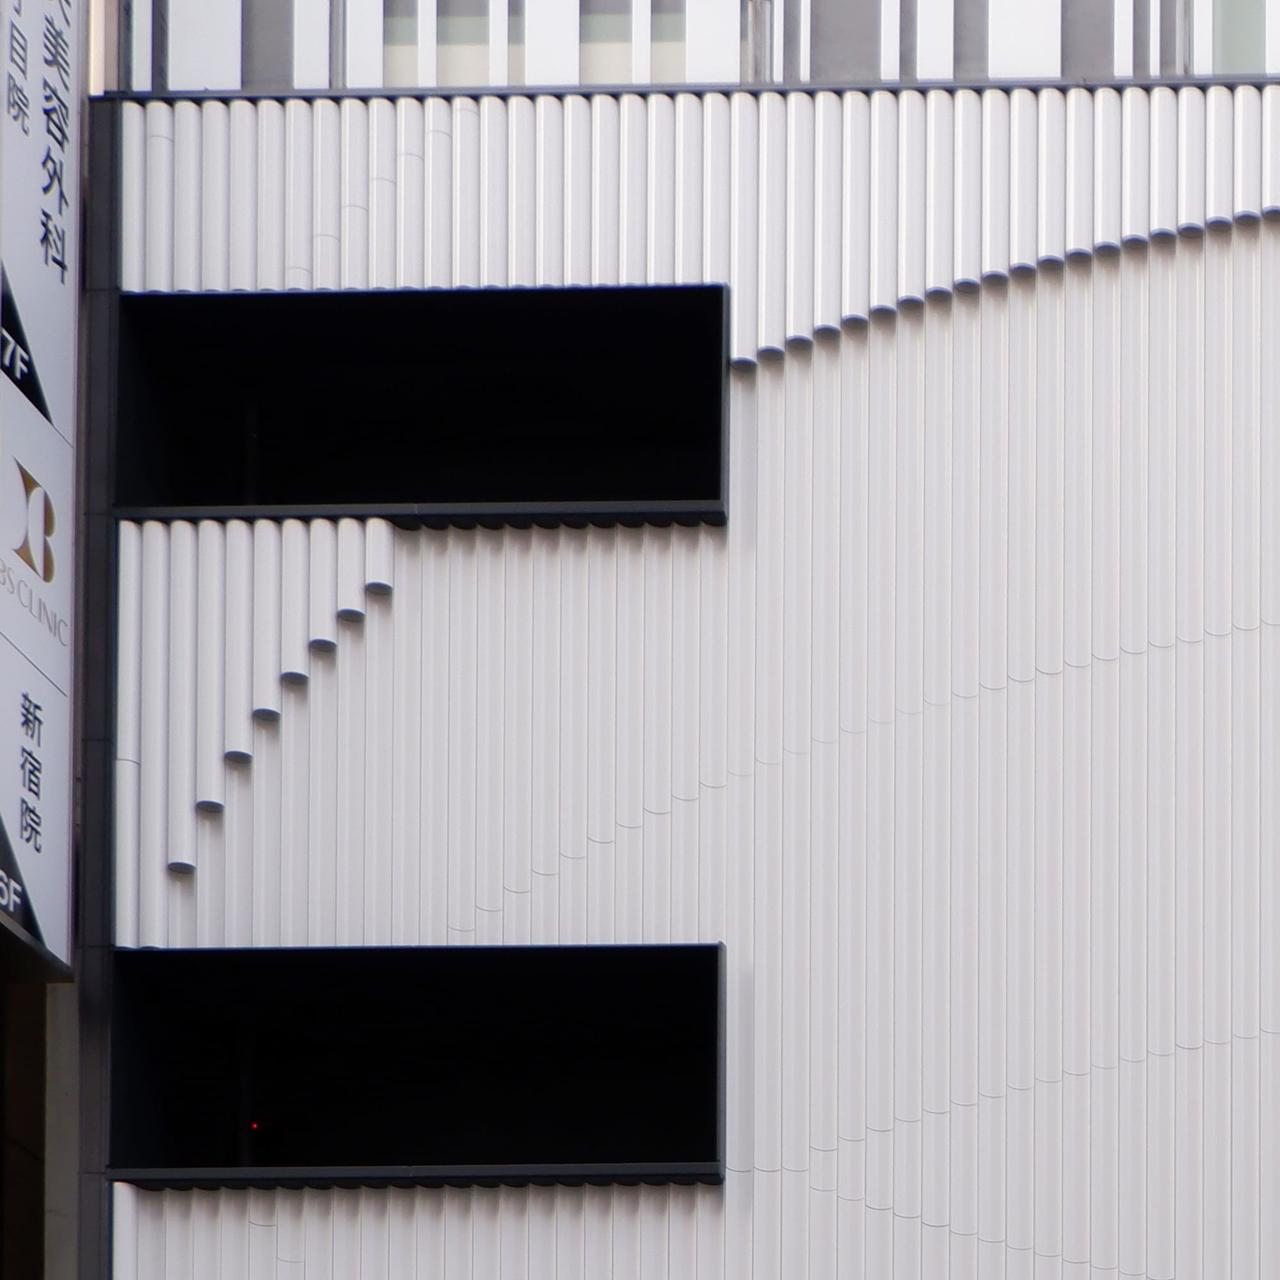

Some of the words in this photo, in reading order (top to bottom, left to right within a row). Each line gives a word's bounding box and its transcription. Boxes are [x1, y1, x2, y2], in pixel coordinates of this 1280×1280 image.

[17, 579, 68, 647] CLINIC
[20, 692, 43, 854] 新宿院
